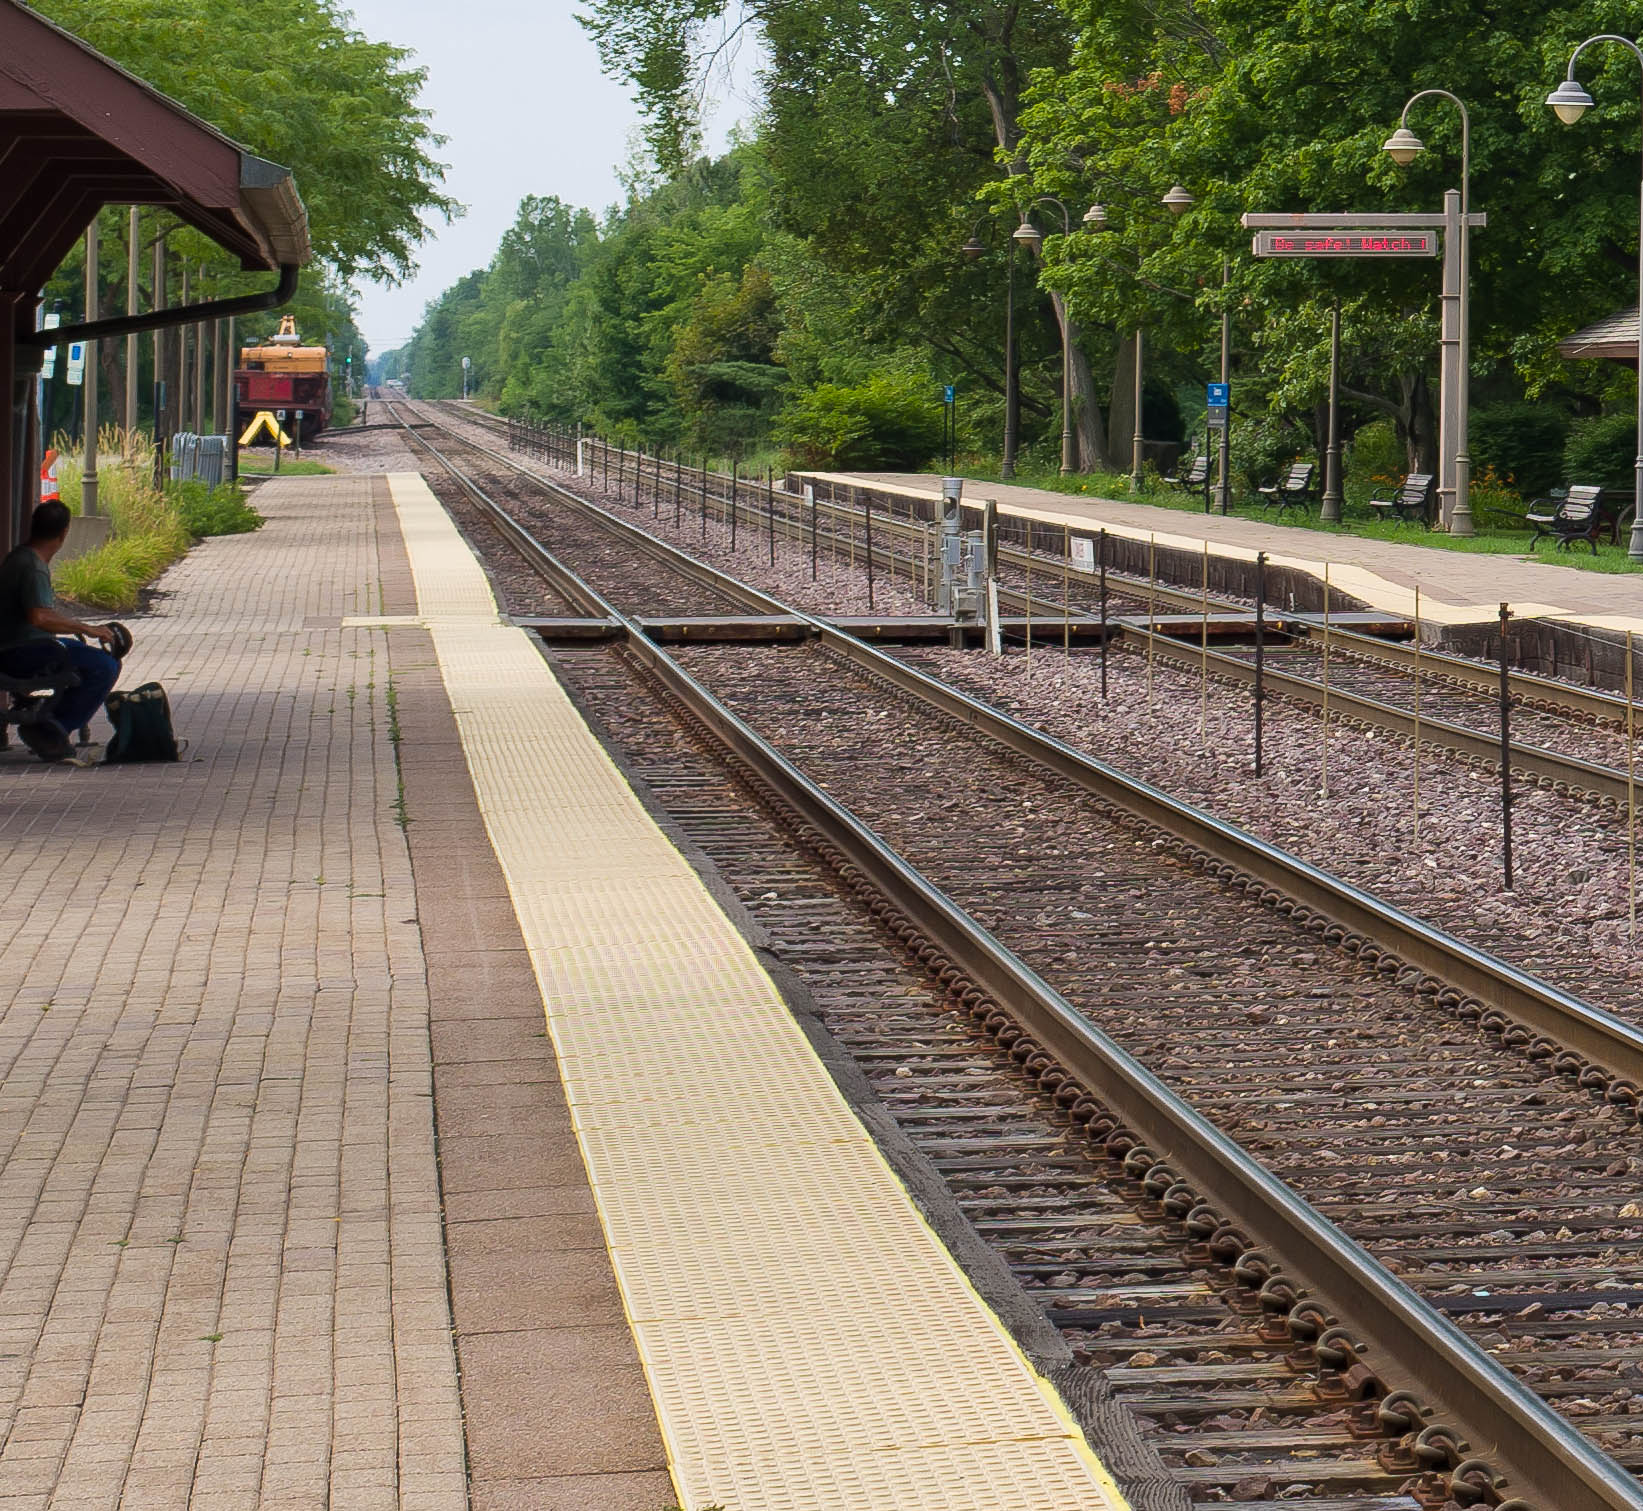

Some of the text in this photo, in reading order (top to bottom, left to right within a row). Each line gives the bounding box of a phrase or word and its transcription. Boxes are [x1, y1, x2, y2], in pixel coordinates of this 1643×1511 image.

[1275, 237, 1294, 250] Be
[1304, 237, 1350, 251] safe!
[1361, 236, 1411, 251] Watch
